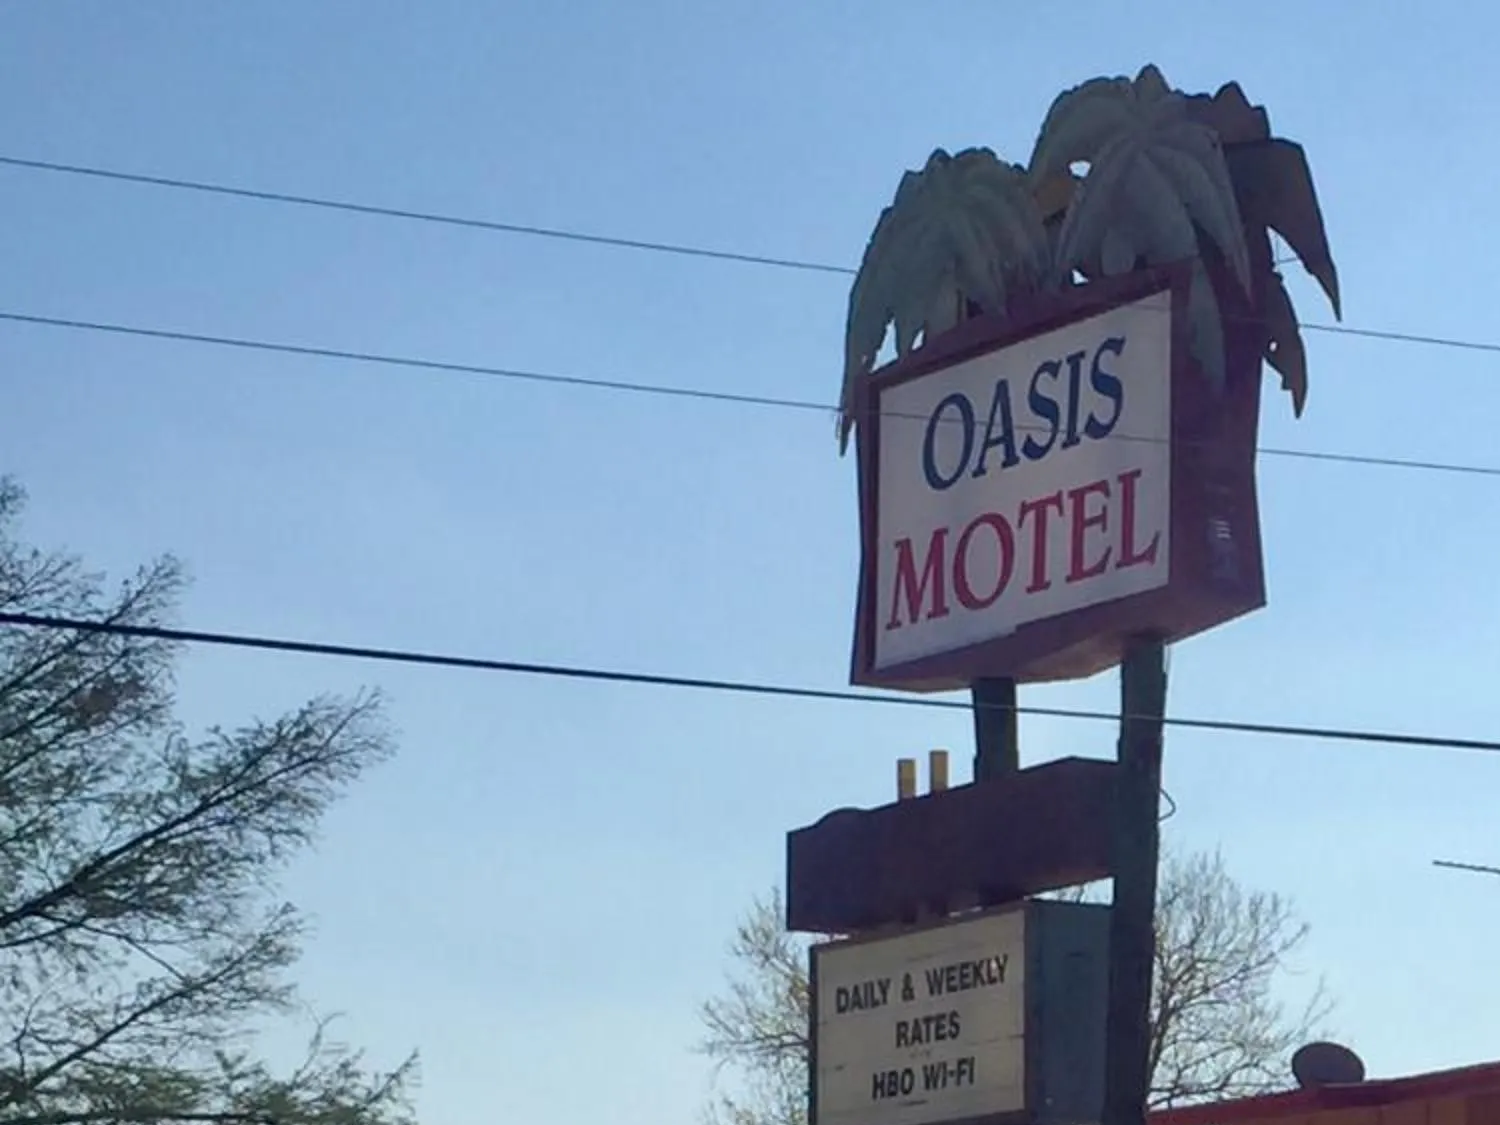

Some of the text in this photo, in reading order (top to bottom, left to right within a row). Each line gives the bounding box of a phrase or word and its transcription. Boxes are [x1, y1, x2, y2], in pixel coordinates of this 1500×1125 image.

[923, 337, 1126, 490] OASIS
[886, 469, 1161, 631] MOTEL
[836, 954, 1008, 1014] DAILY & WEEKLY
[895, 1011, 960, 1049] RATES
[872, 1056, 975, 1100] HBO WI-FI
